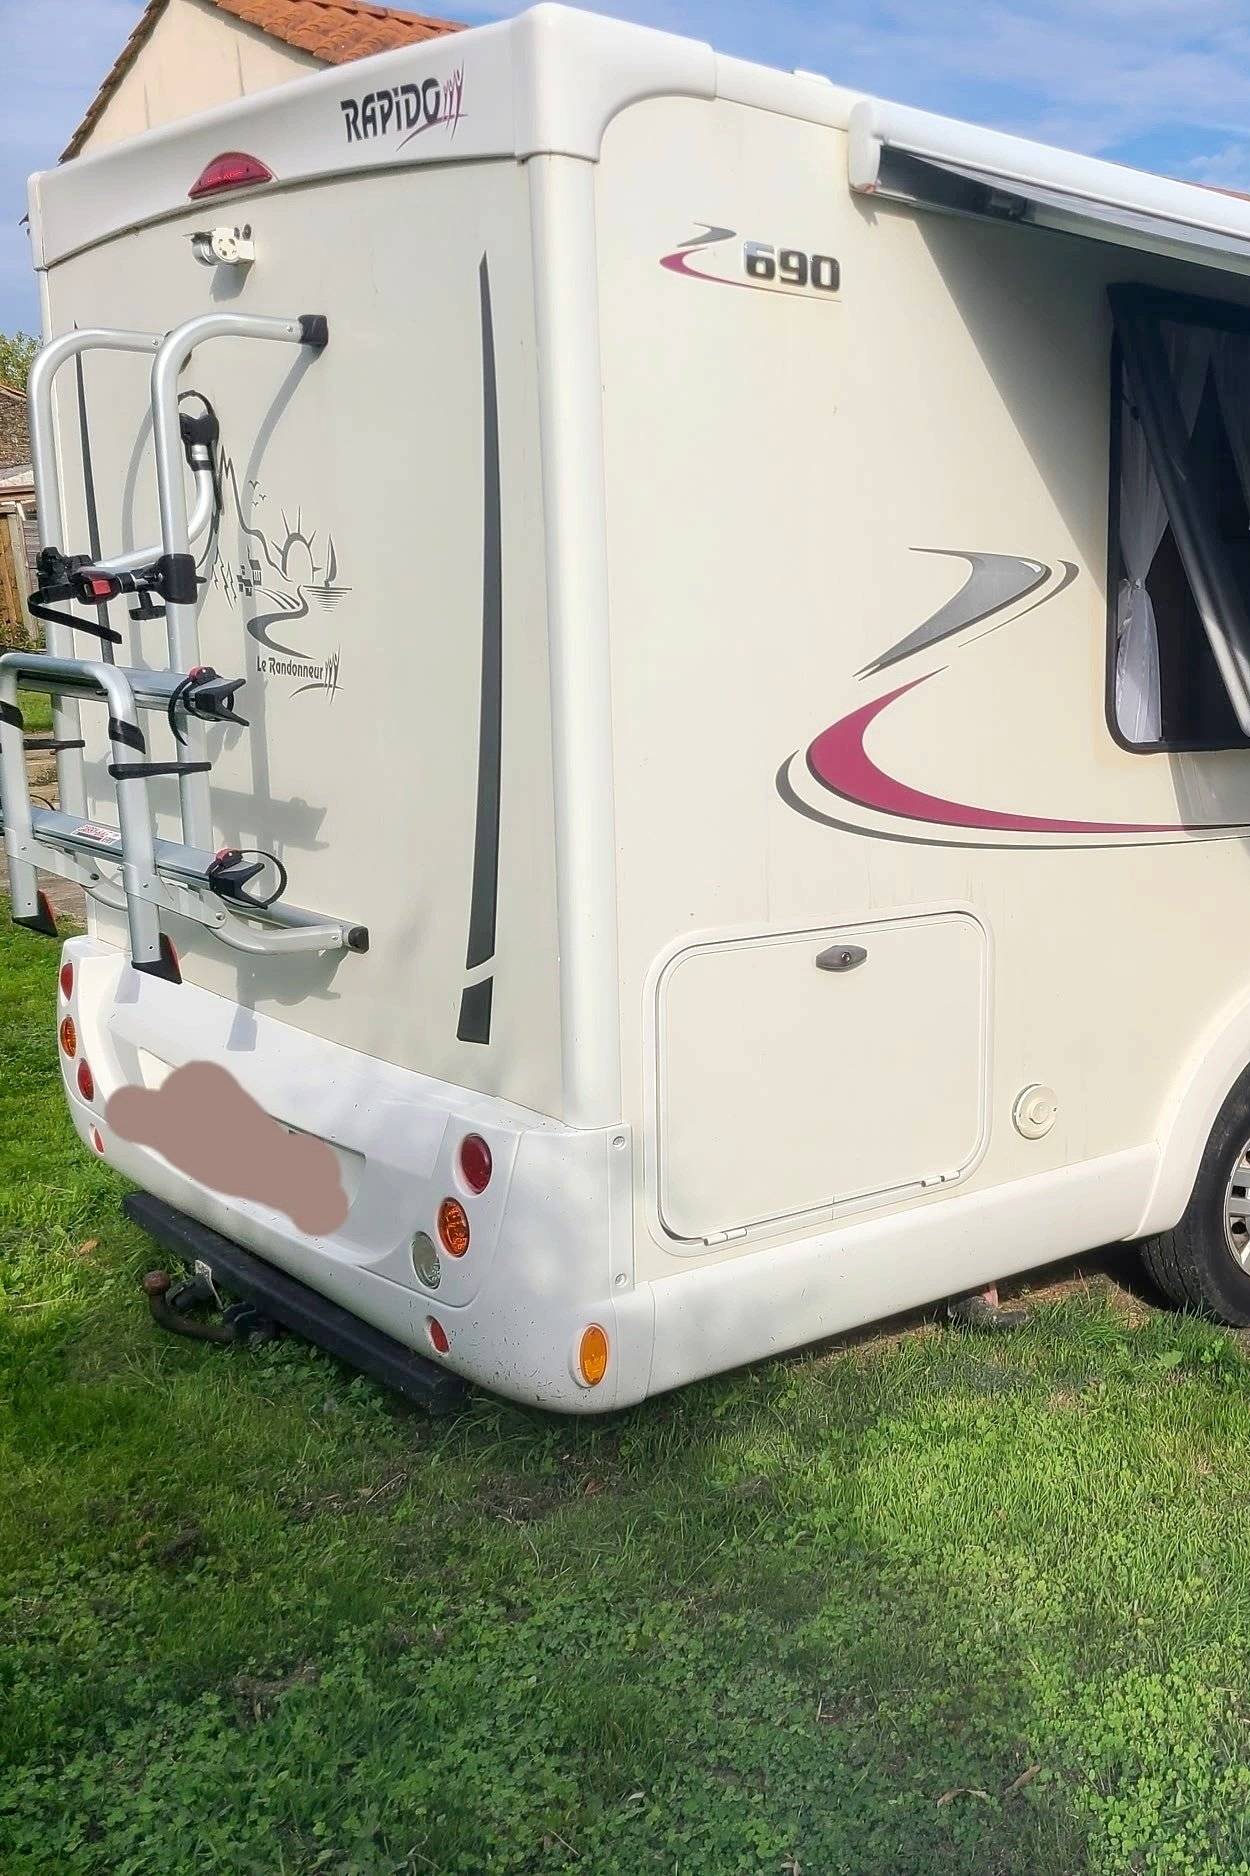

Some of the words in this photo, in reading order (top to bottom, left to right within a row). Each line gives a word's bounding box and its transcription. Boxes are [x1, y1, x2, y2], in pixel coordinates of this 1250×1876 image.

[743, 240, 841, 293] 690
[257, 655, 267, 672] Le
[268, 656, 324, 680] Randonneur
